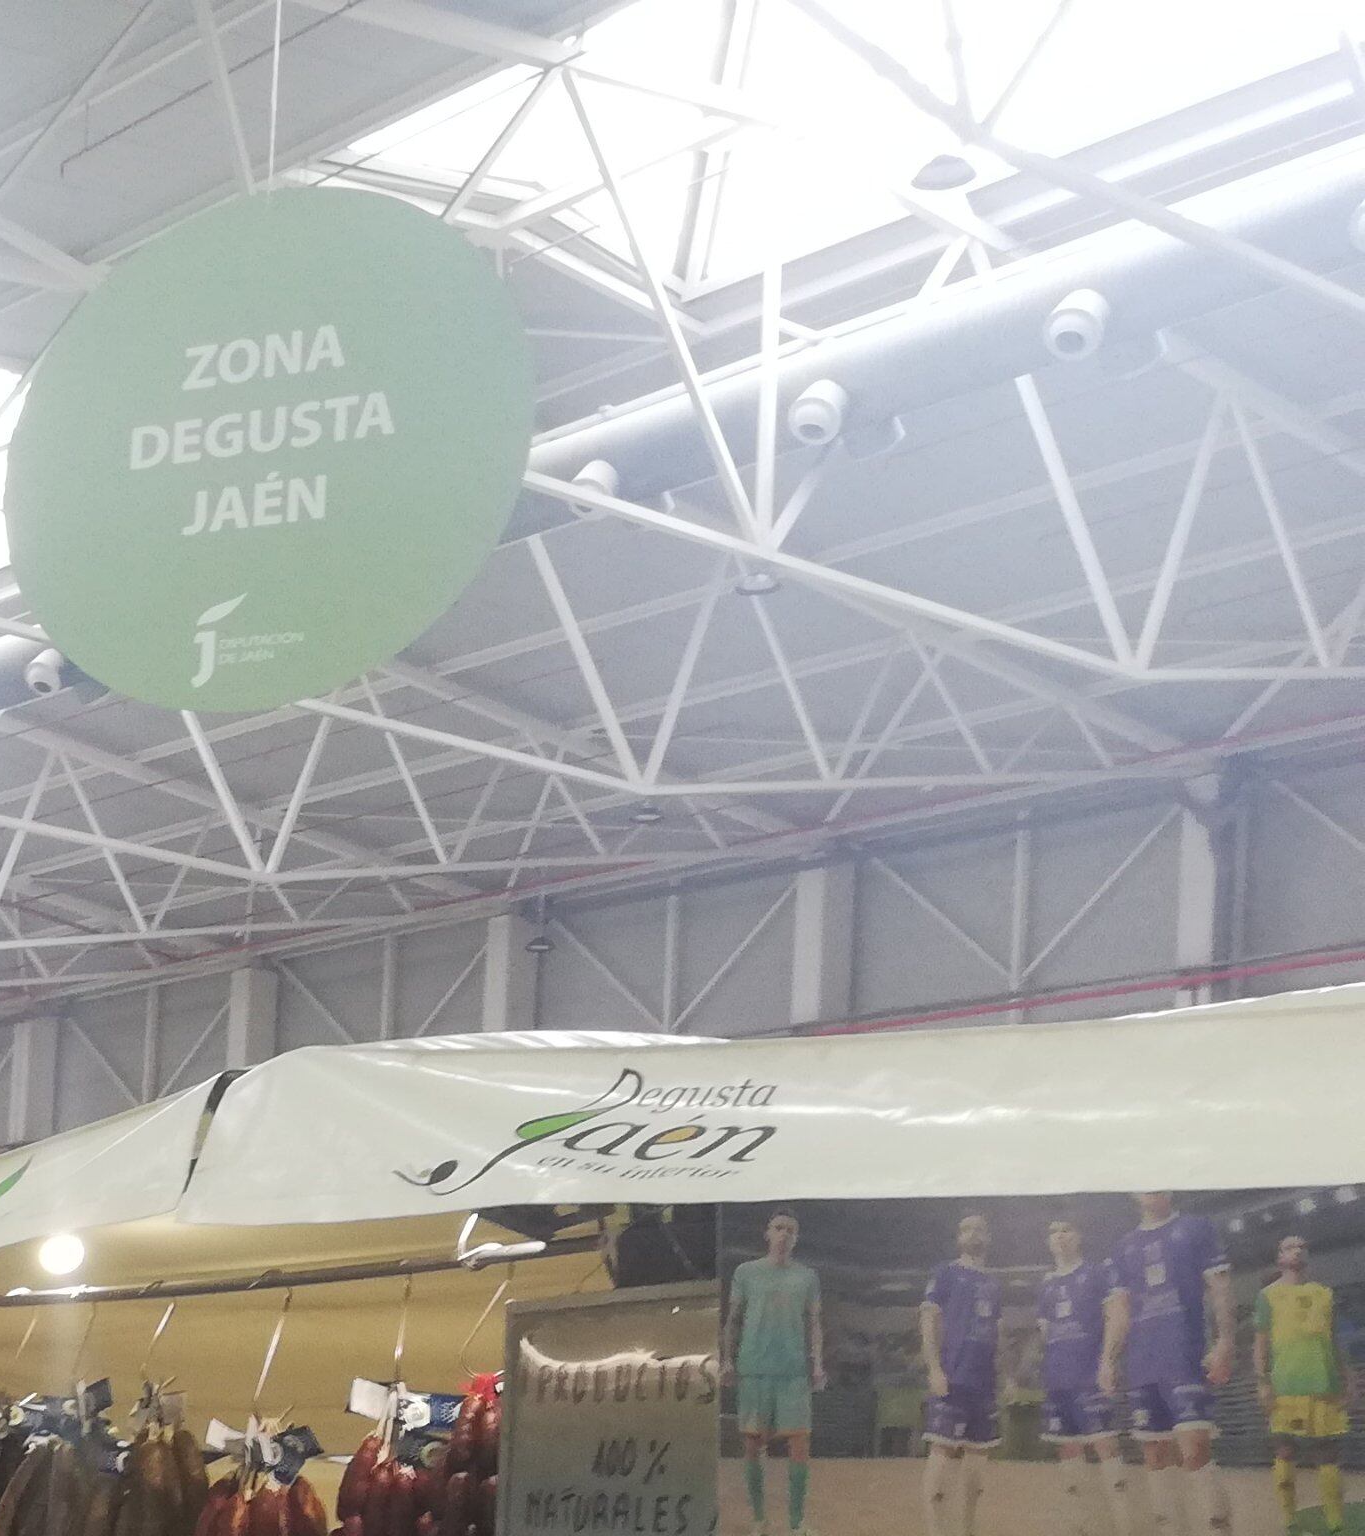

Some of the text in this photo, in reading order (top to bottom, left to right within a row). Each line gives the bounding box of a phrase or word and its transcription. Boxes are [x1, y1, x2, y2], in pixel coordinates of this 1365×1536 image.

[182, 325, 346, 391] ZONA
[128, 391, 395, 471] DEGUSTA
[181, 471, 329, 537] JAÉN
[604, 1068, 778, 1114] Degusta
